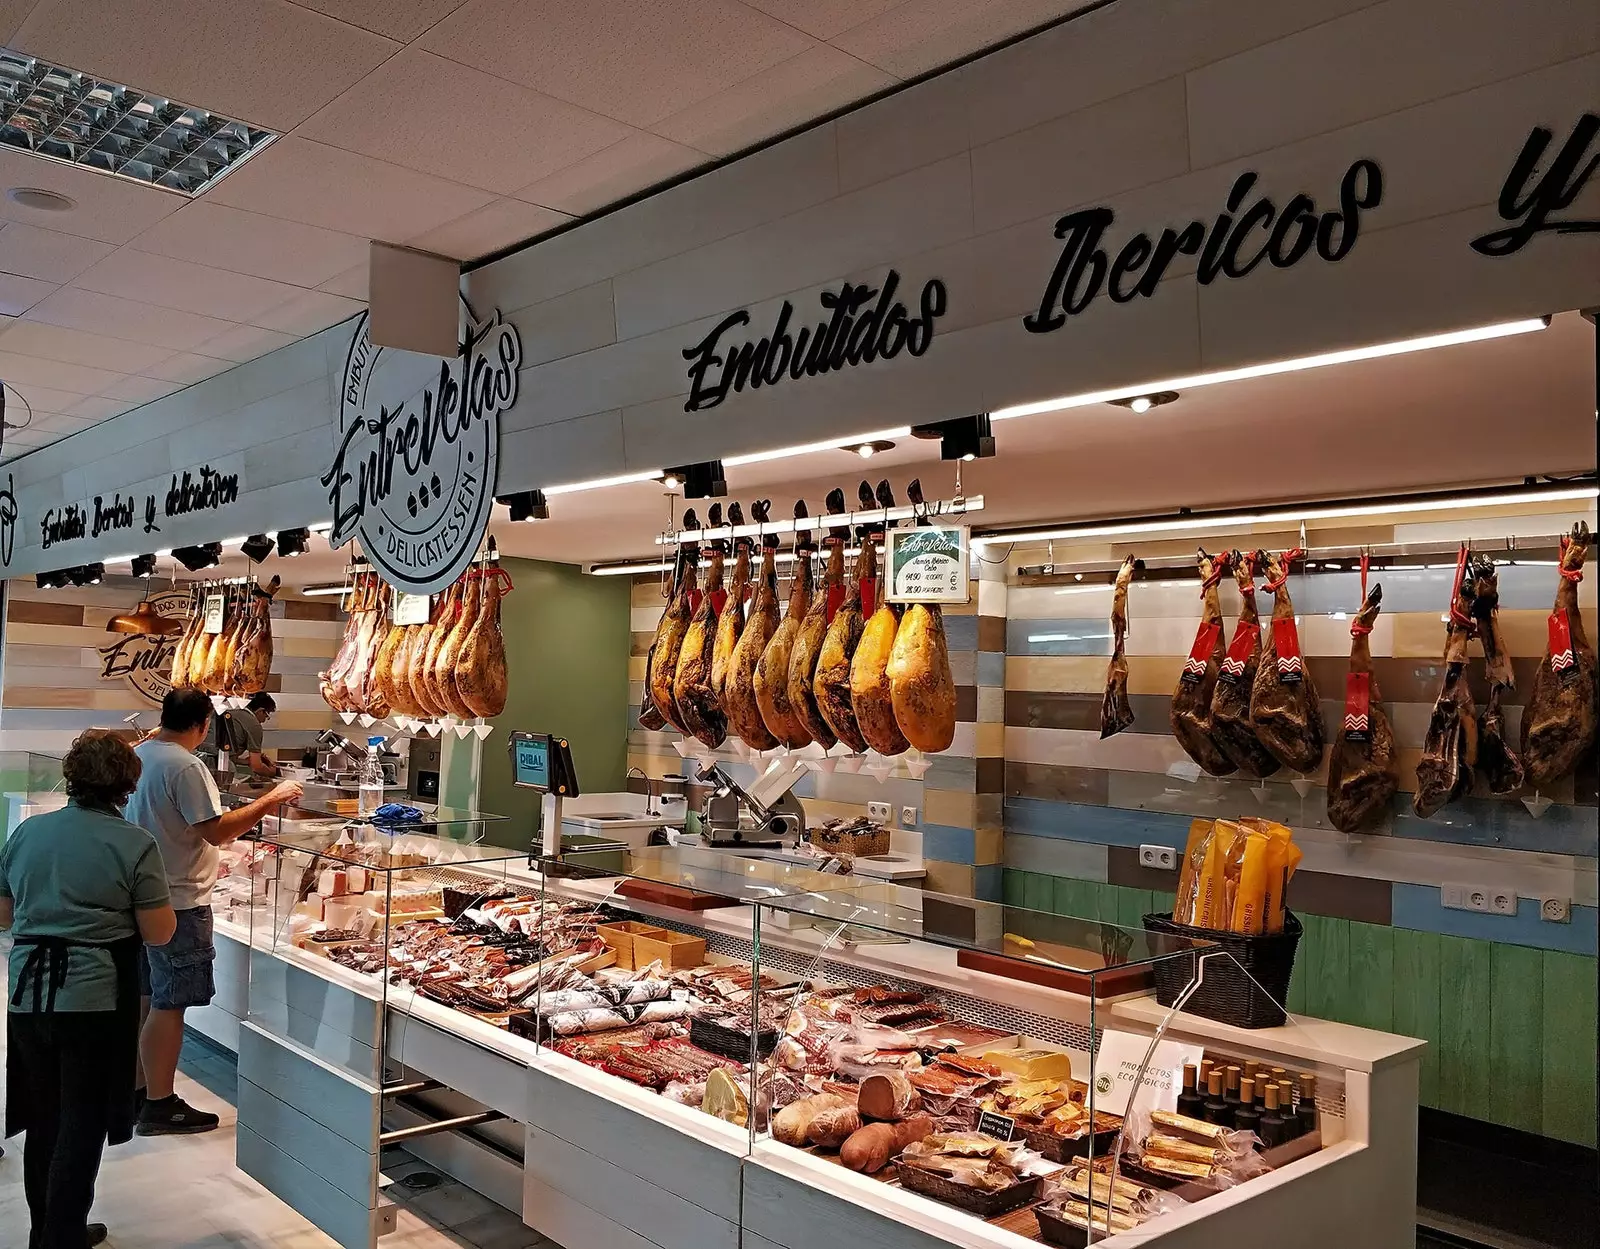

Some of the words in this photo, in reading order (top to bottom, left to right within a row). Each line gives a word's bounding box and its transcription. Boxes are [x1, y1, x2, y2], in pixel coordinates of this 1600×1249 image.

[682, 269, 946, 412] Embutidos
[40, 503, 87, 549] Embutidos
[387, 471, 477, 568] DELICATESSEN
[520, 753, 543, 766] DIBAL
[1117, 1072, 1171, 1091] ECOOGICOS
